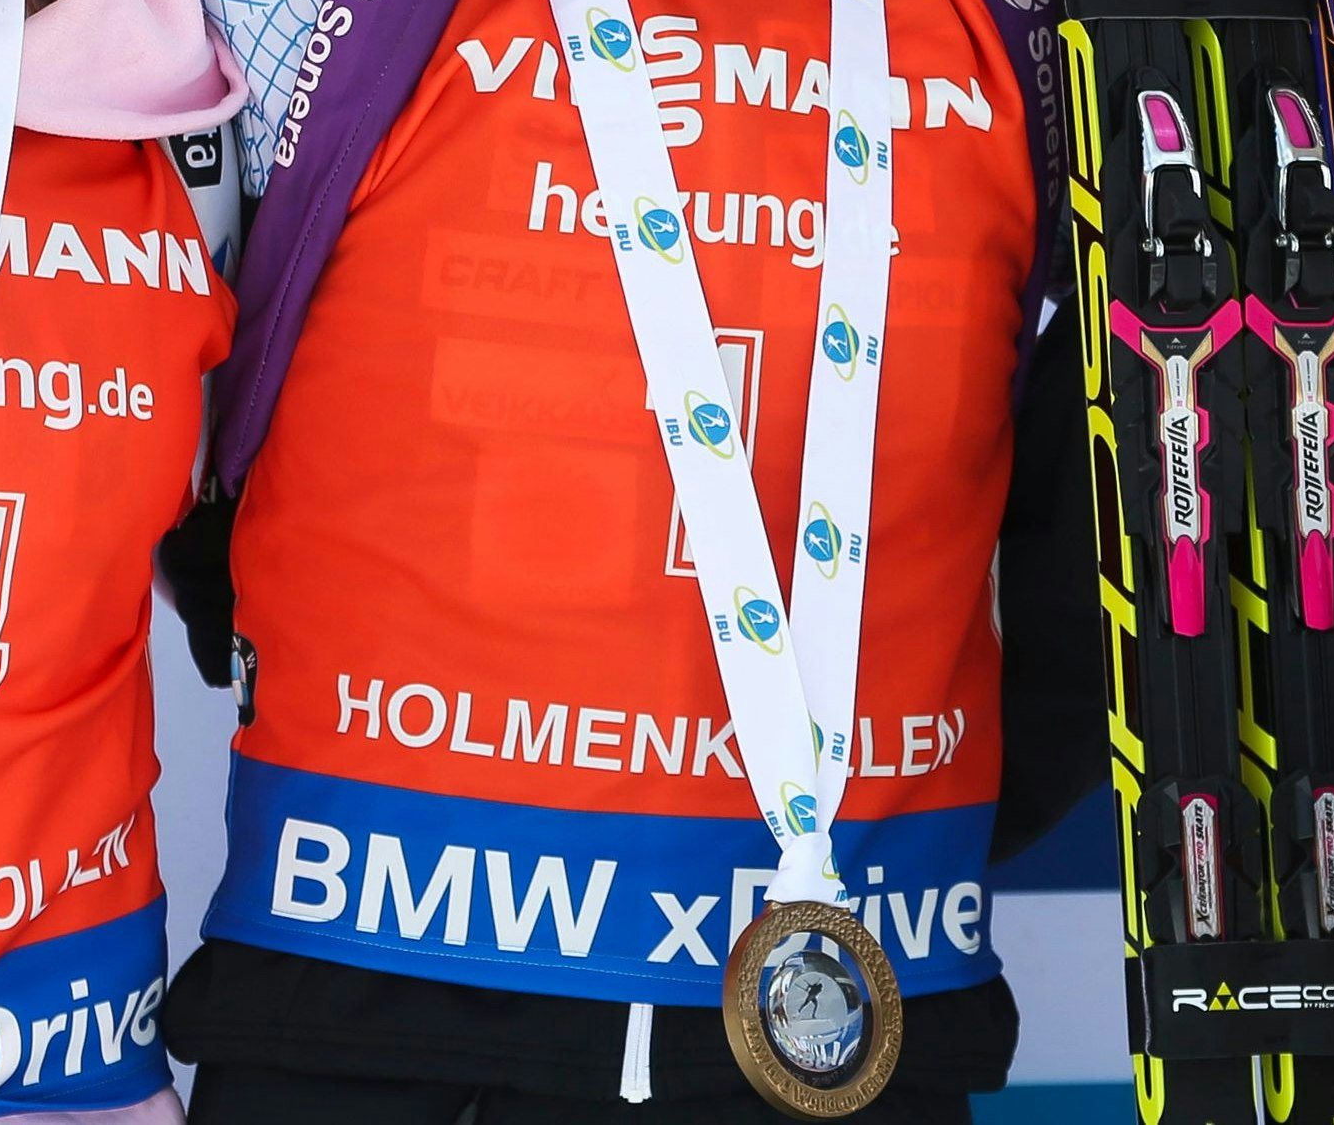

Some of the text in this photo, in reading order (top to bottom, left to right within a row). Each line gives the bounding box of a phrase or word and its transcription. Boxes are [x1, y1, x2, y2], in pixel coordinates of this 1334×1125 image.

[567, 35, 585, 63] IBU
[1027, 24, 1063, 206] Sonera
[876, 141, 888, 170] IBU
[614, 223, 633, 252] IBU
[865, 335, 879, 366] IBU
[664, 418, 683, 447] IBU
[848, 534, 862, 563] IBU
[715, 614, 733, 644] IBU
[831, 732, 846, 763] IBU
[765, 810, 785, 838] IBU
[270, 817, 618, 959] BMW
